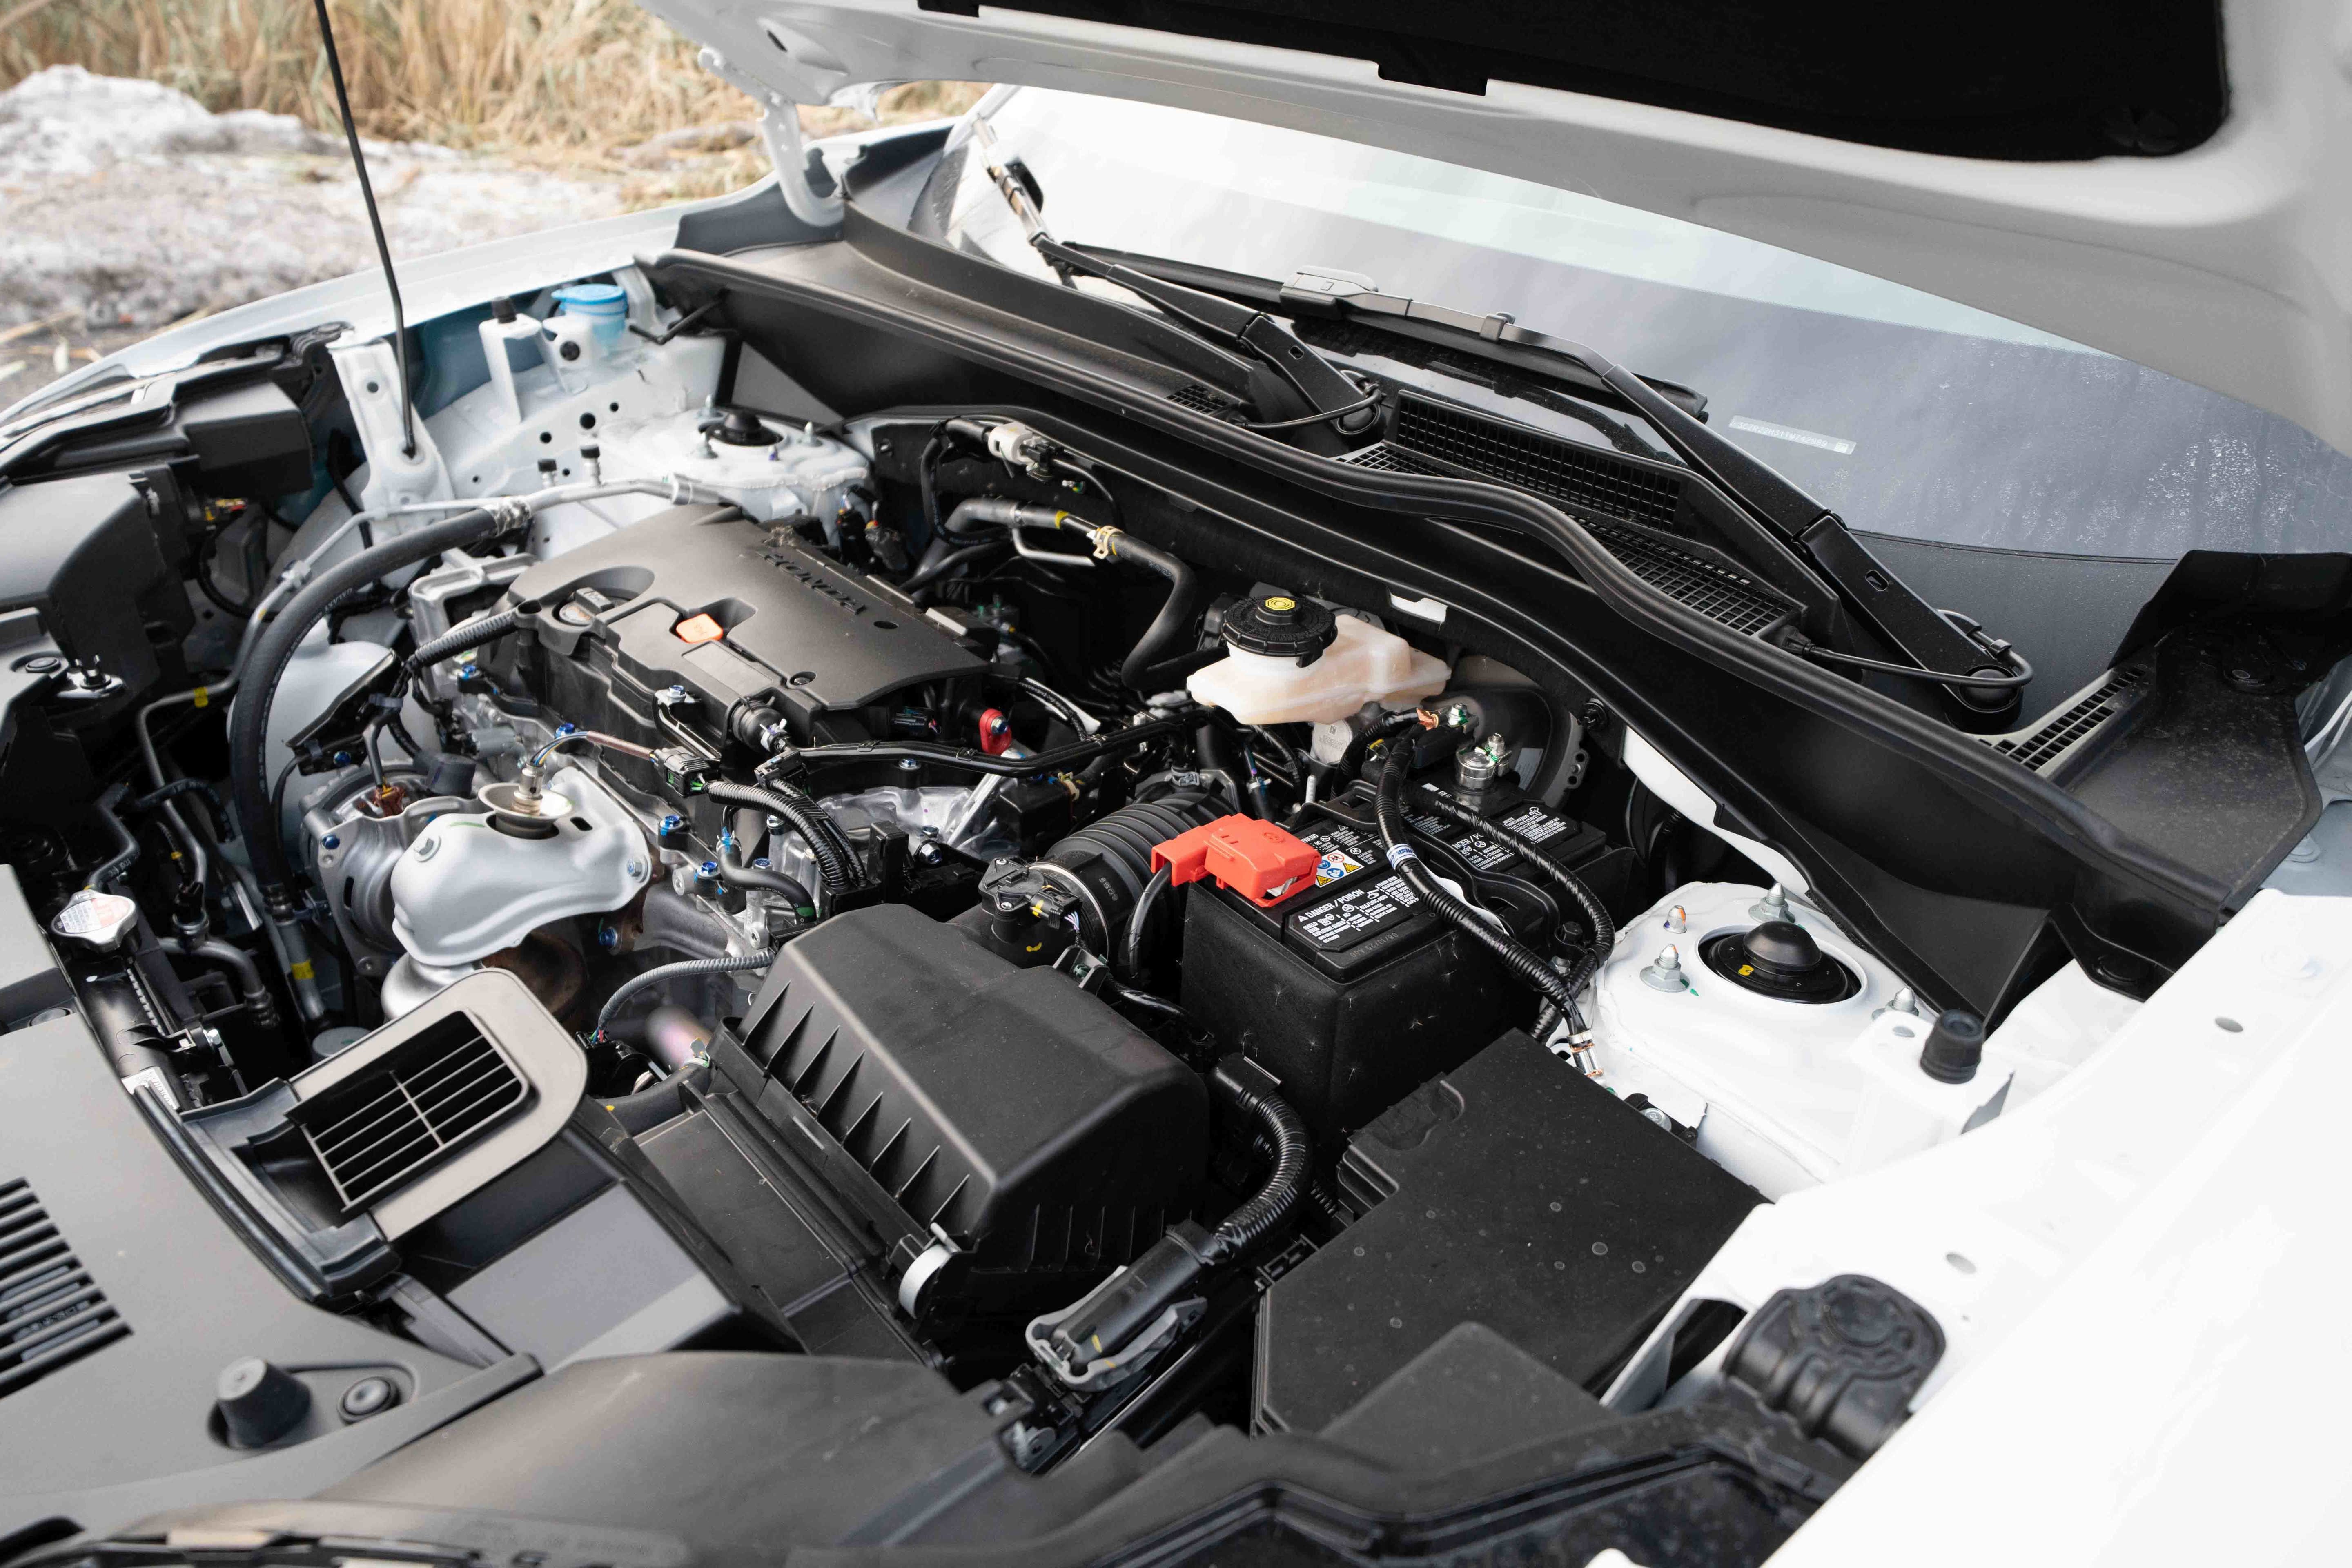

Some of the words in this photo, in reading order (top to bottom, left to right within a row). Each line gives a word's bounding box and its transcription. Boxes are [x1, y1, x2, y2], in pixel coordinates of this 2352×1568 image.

[1301, 833, 1319, 843] ENENO
[1451, 837, 1472, 849] NGER
[1305, 902, 1336, 918] DANGER
[1337, 889, 1365, 904] POISON
